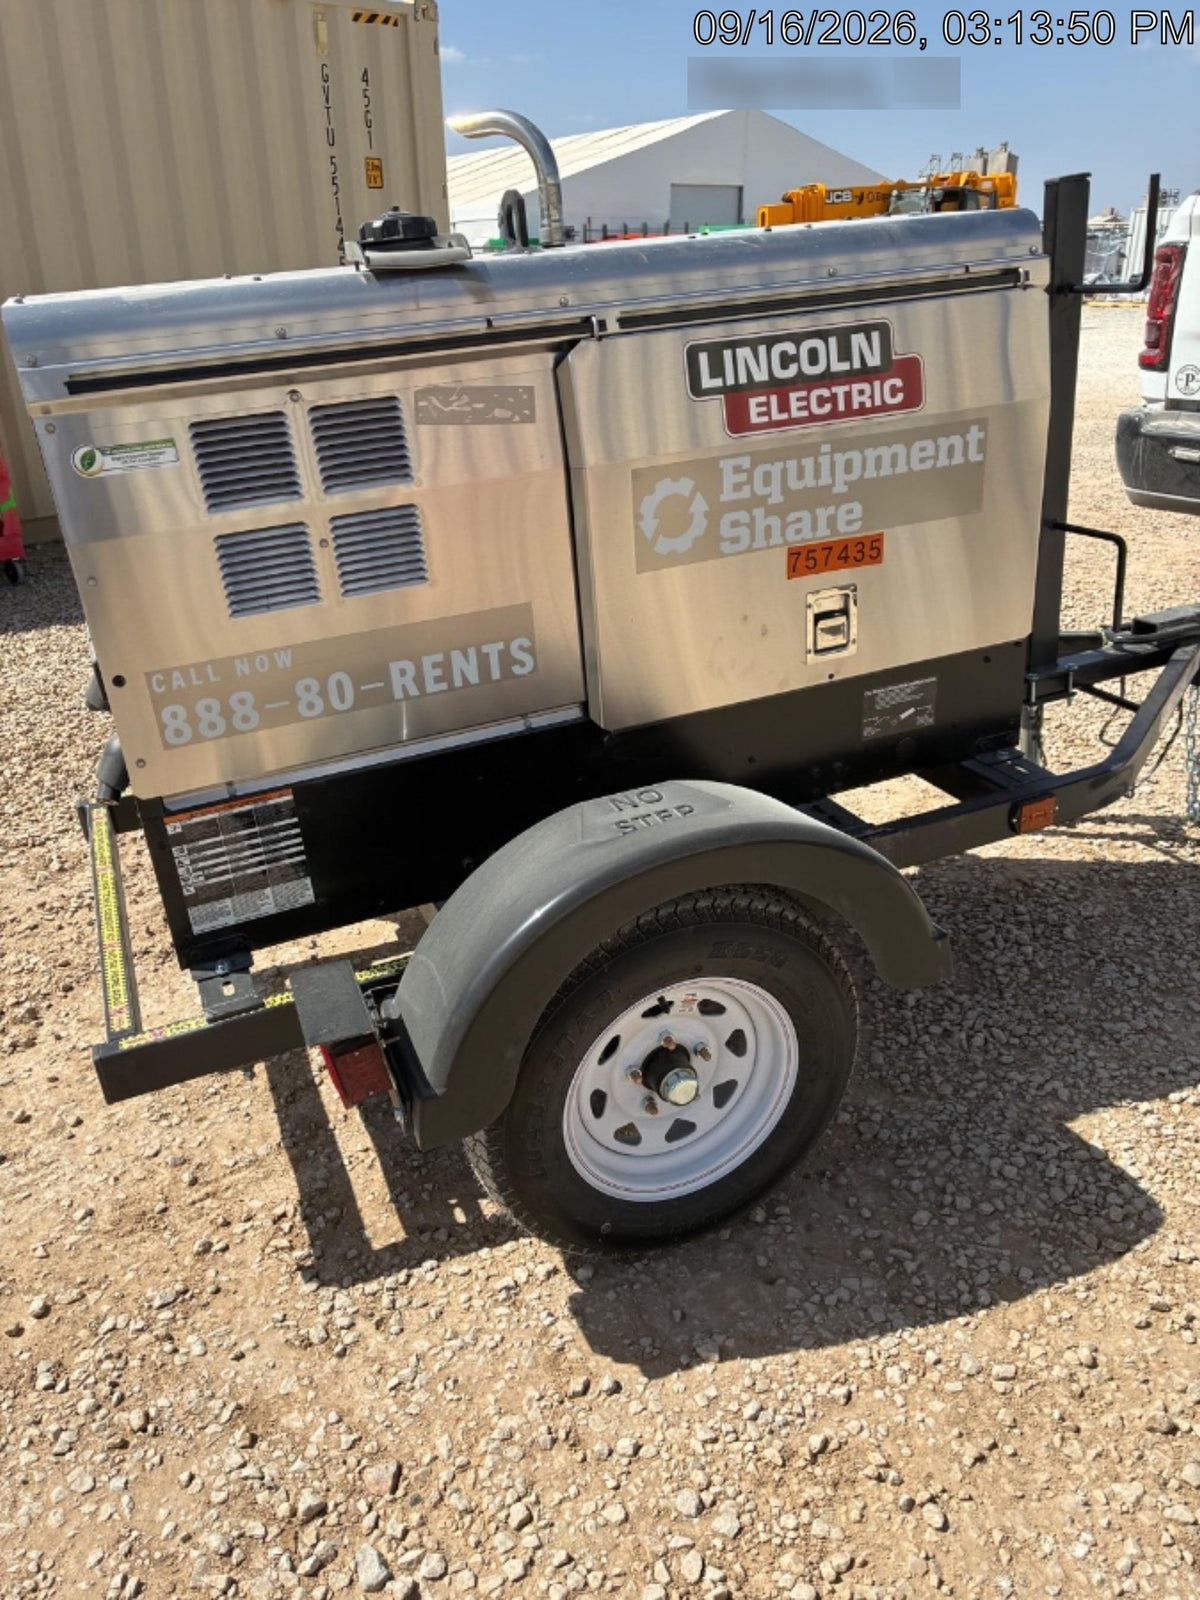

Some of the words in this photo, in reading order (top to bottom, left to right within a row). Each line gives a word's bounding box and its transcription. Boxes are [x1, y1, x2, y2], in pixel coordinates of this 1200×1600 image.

[321, 63, 336, 148] GVTU
[361, 66, 374, 150] 45G1
[825, 190, 853, 204] JCB
[698, 330, 882, 390] LINCOLN
[748, 377, 905, 425] ELECTRIC
[718, 424, 986, 506] Equipment
[719, 500, 864, 555] Share
[788, 538, 883, 574] 757435
[151, 664, 221, 694] CALL
[234, 649, 294, 679] NOW
[160, 637, 535, 747] 888-80-RENTS
[608, 788, 663, 812] NO
[614, 804, 695, 836] STEP
